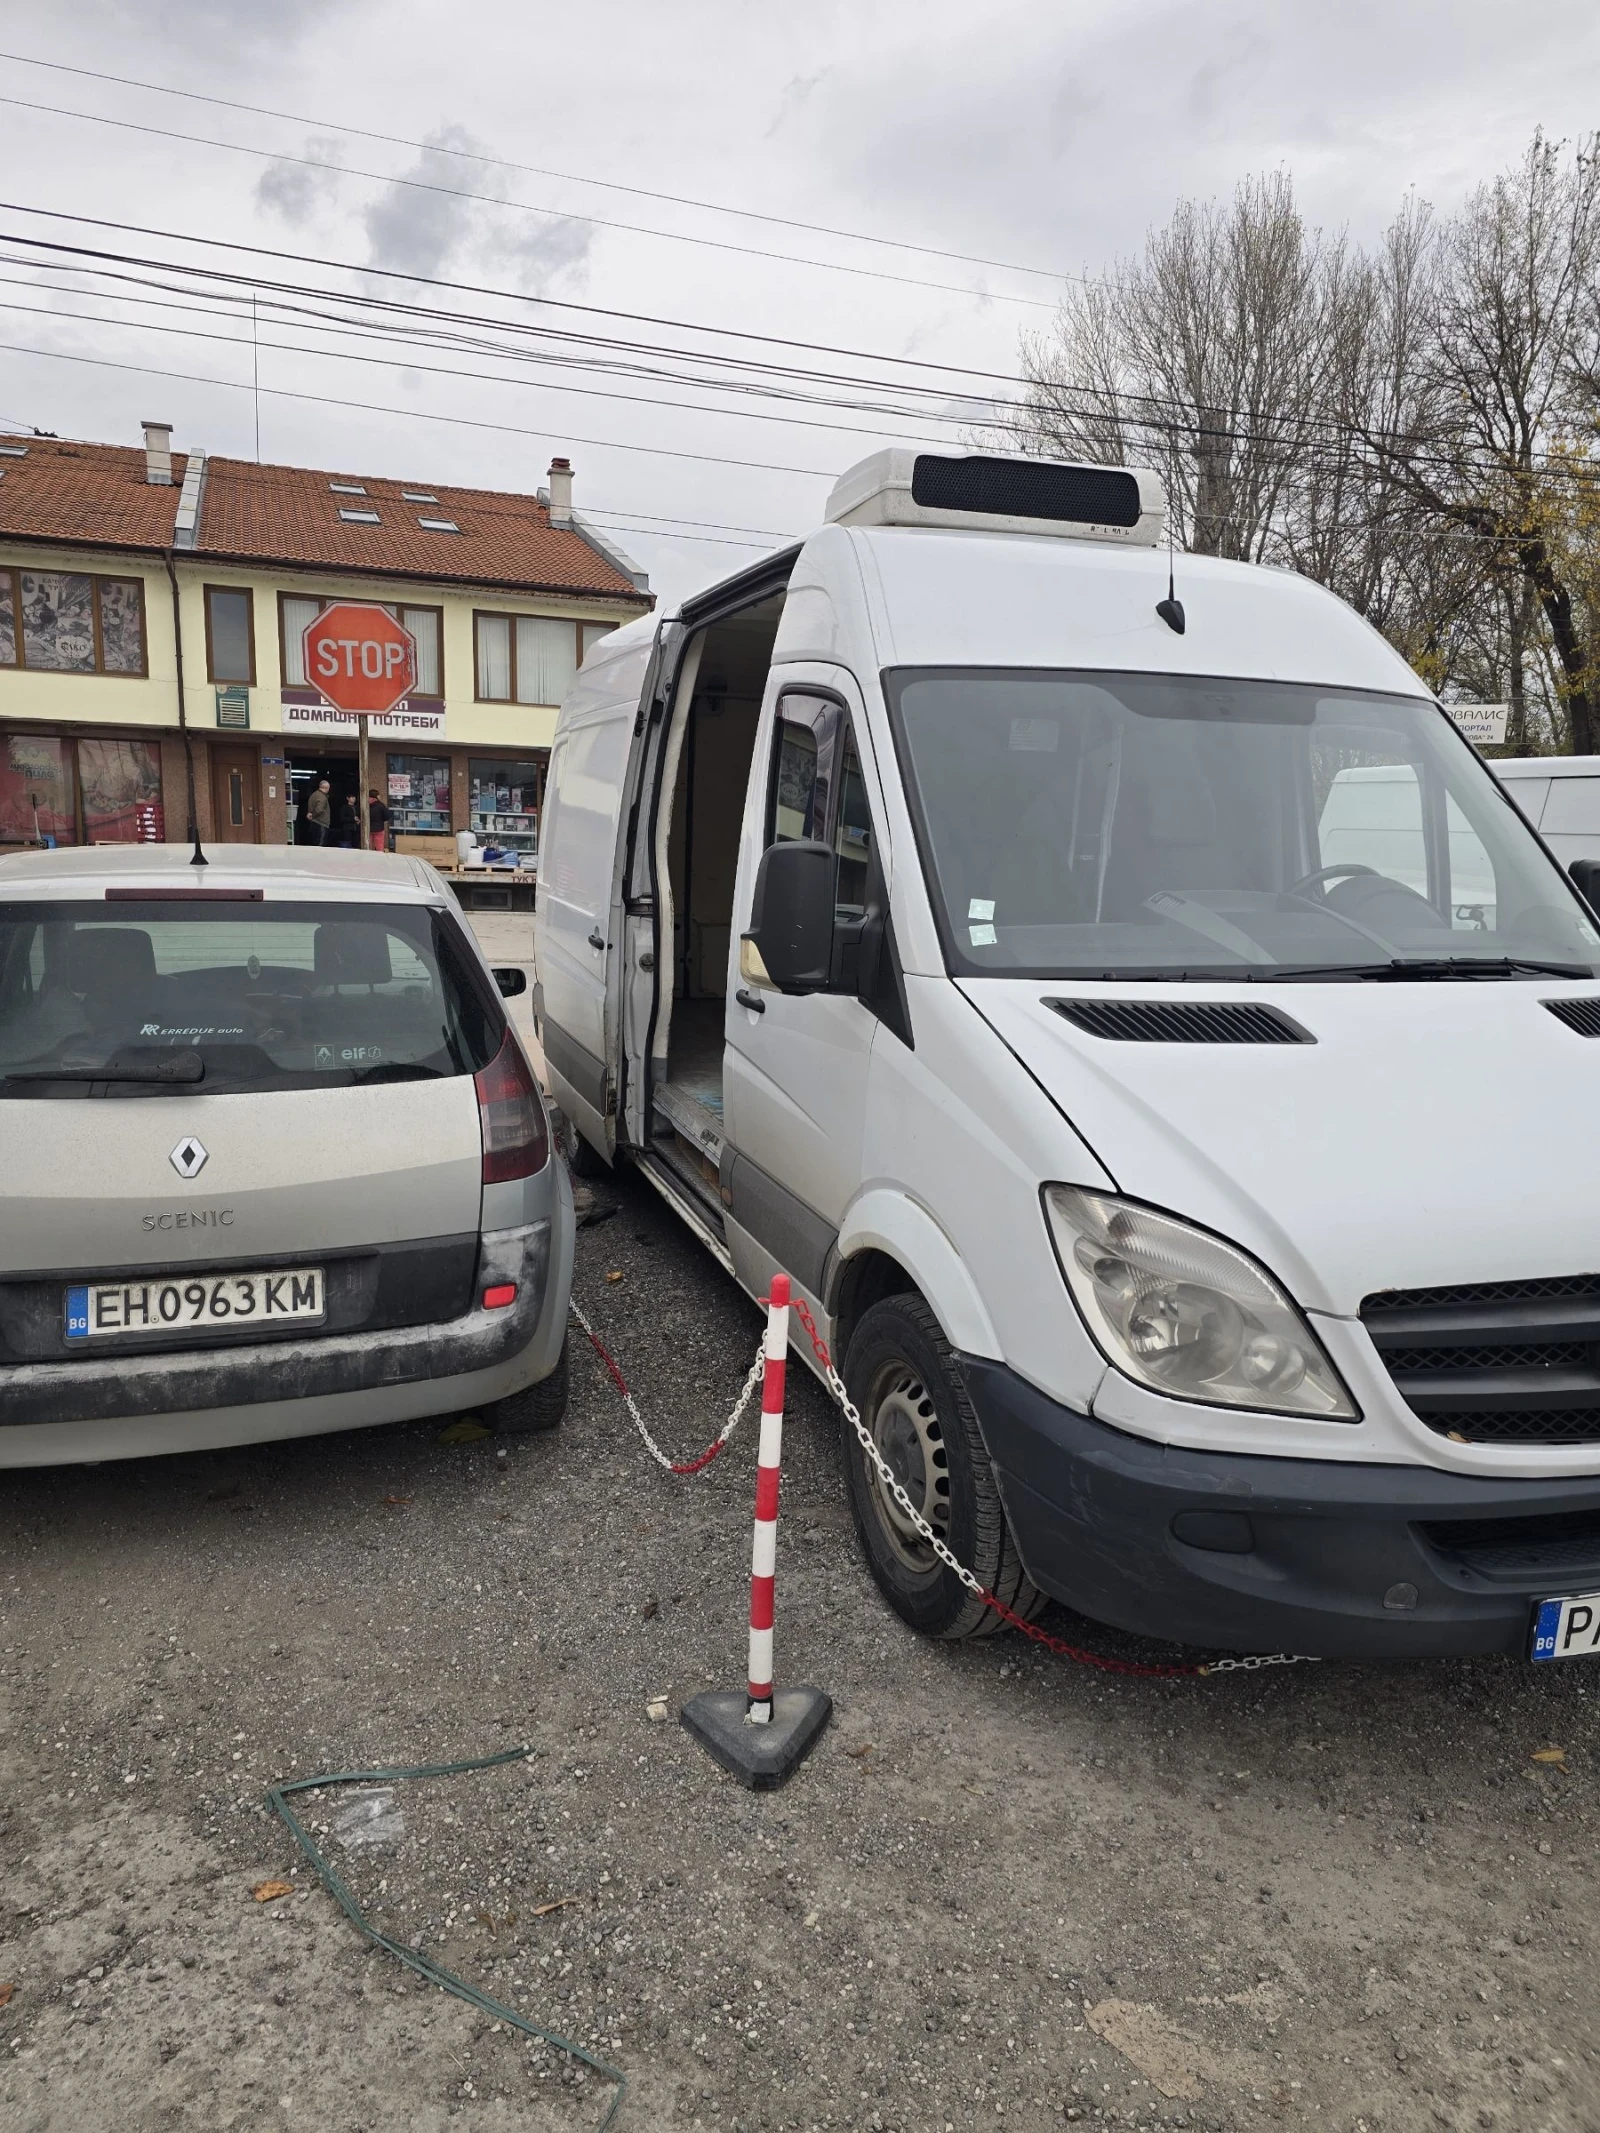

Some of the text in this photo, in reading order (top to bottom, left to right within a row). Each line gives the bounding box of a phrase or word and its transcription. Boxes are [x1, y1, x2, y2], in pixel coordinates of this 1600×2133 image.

[317, 638, 405, 679] STOP
[373, 714, 439, 729] ПОТРЕБИ
[1446, 710, 1505, 720] ОВАЛИС
[160, 1027, 215, 1035] ERREDUE
[341, 1047, 366, 1060] elf
[142, 1208, 234, 1231] SCENIC
[69, 1317, 87, 1330] BG
[1536, 1636, 1554, 1651] BG
